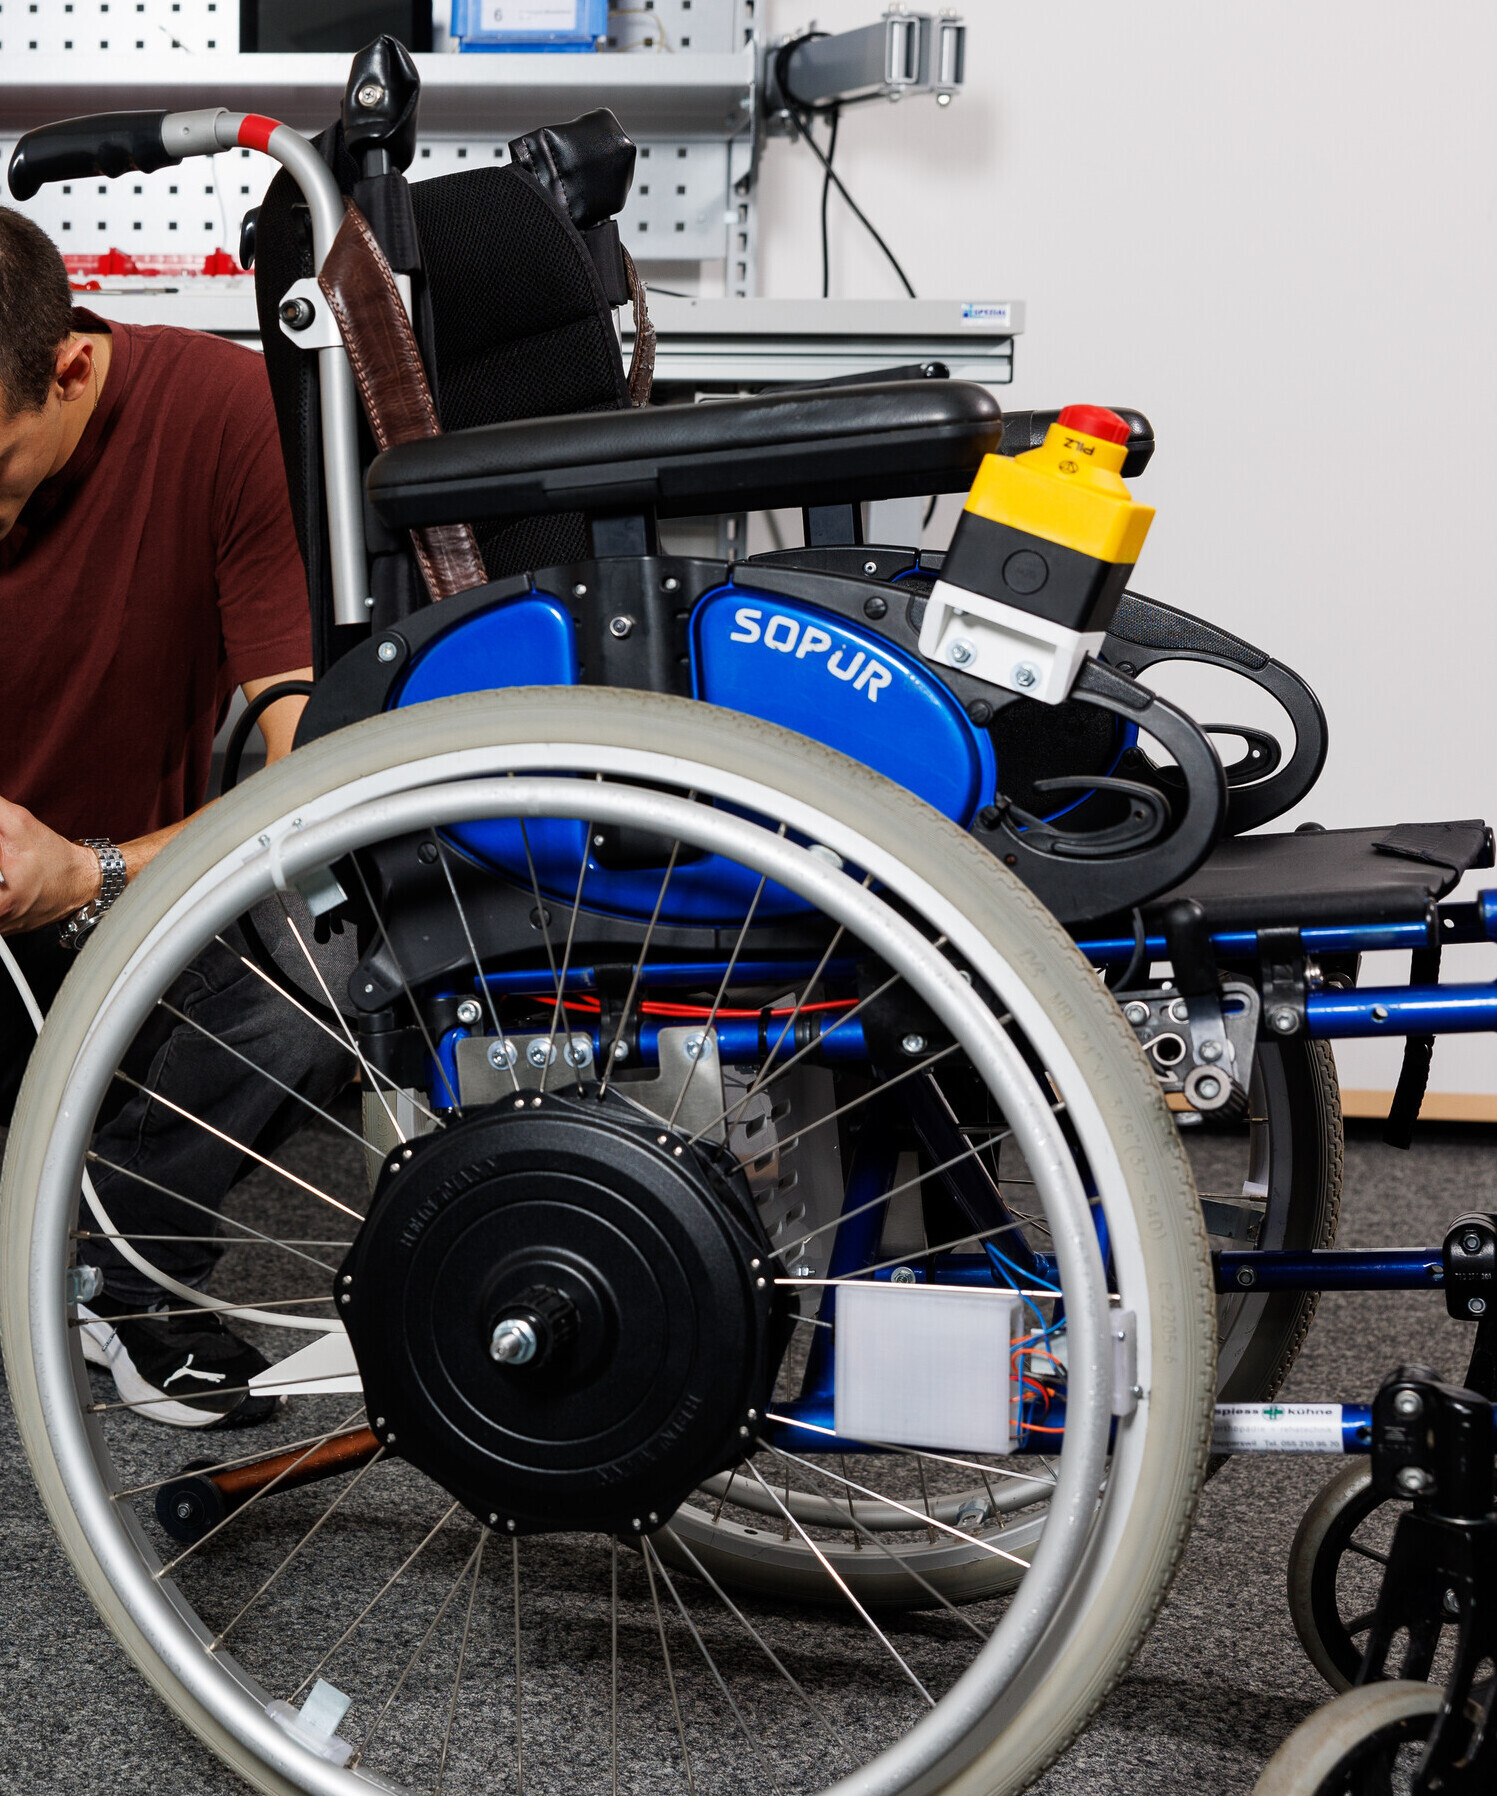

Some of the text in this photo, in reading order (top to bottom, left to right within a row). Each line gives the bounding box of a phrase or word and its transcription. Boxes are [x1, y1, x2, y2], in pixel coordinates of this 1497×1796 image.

[493, 8, 503, 22] 6
[1063, 437, 1096, 456] PILZ
[730, 607, 893, 703] SOPUR
